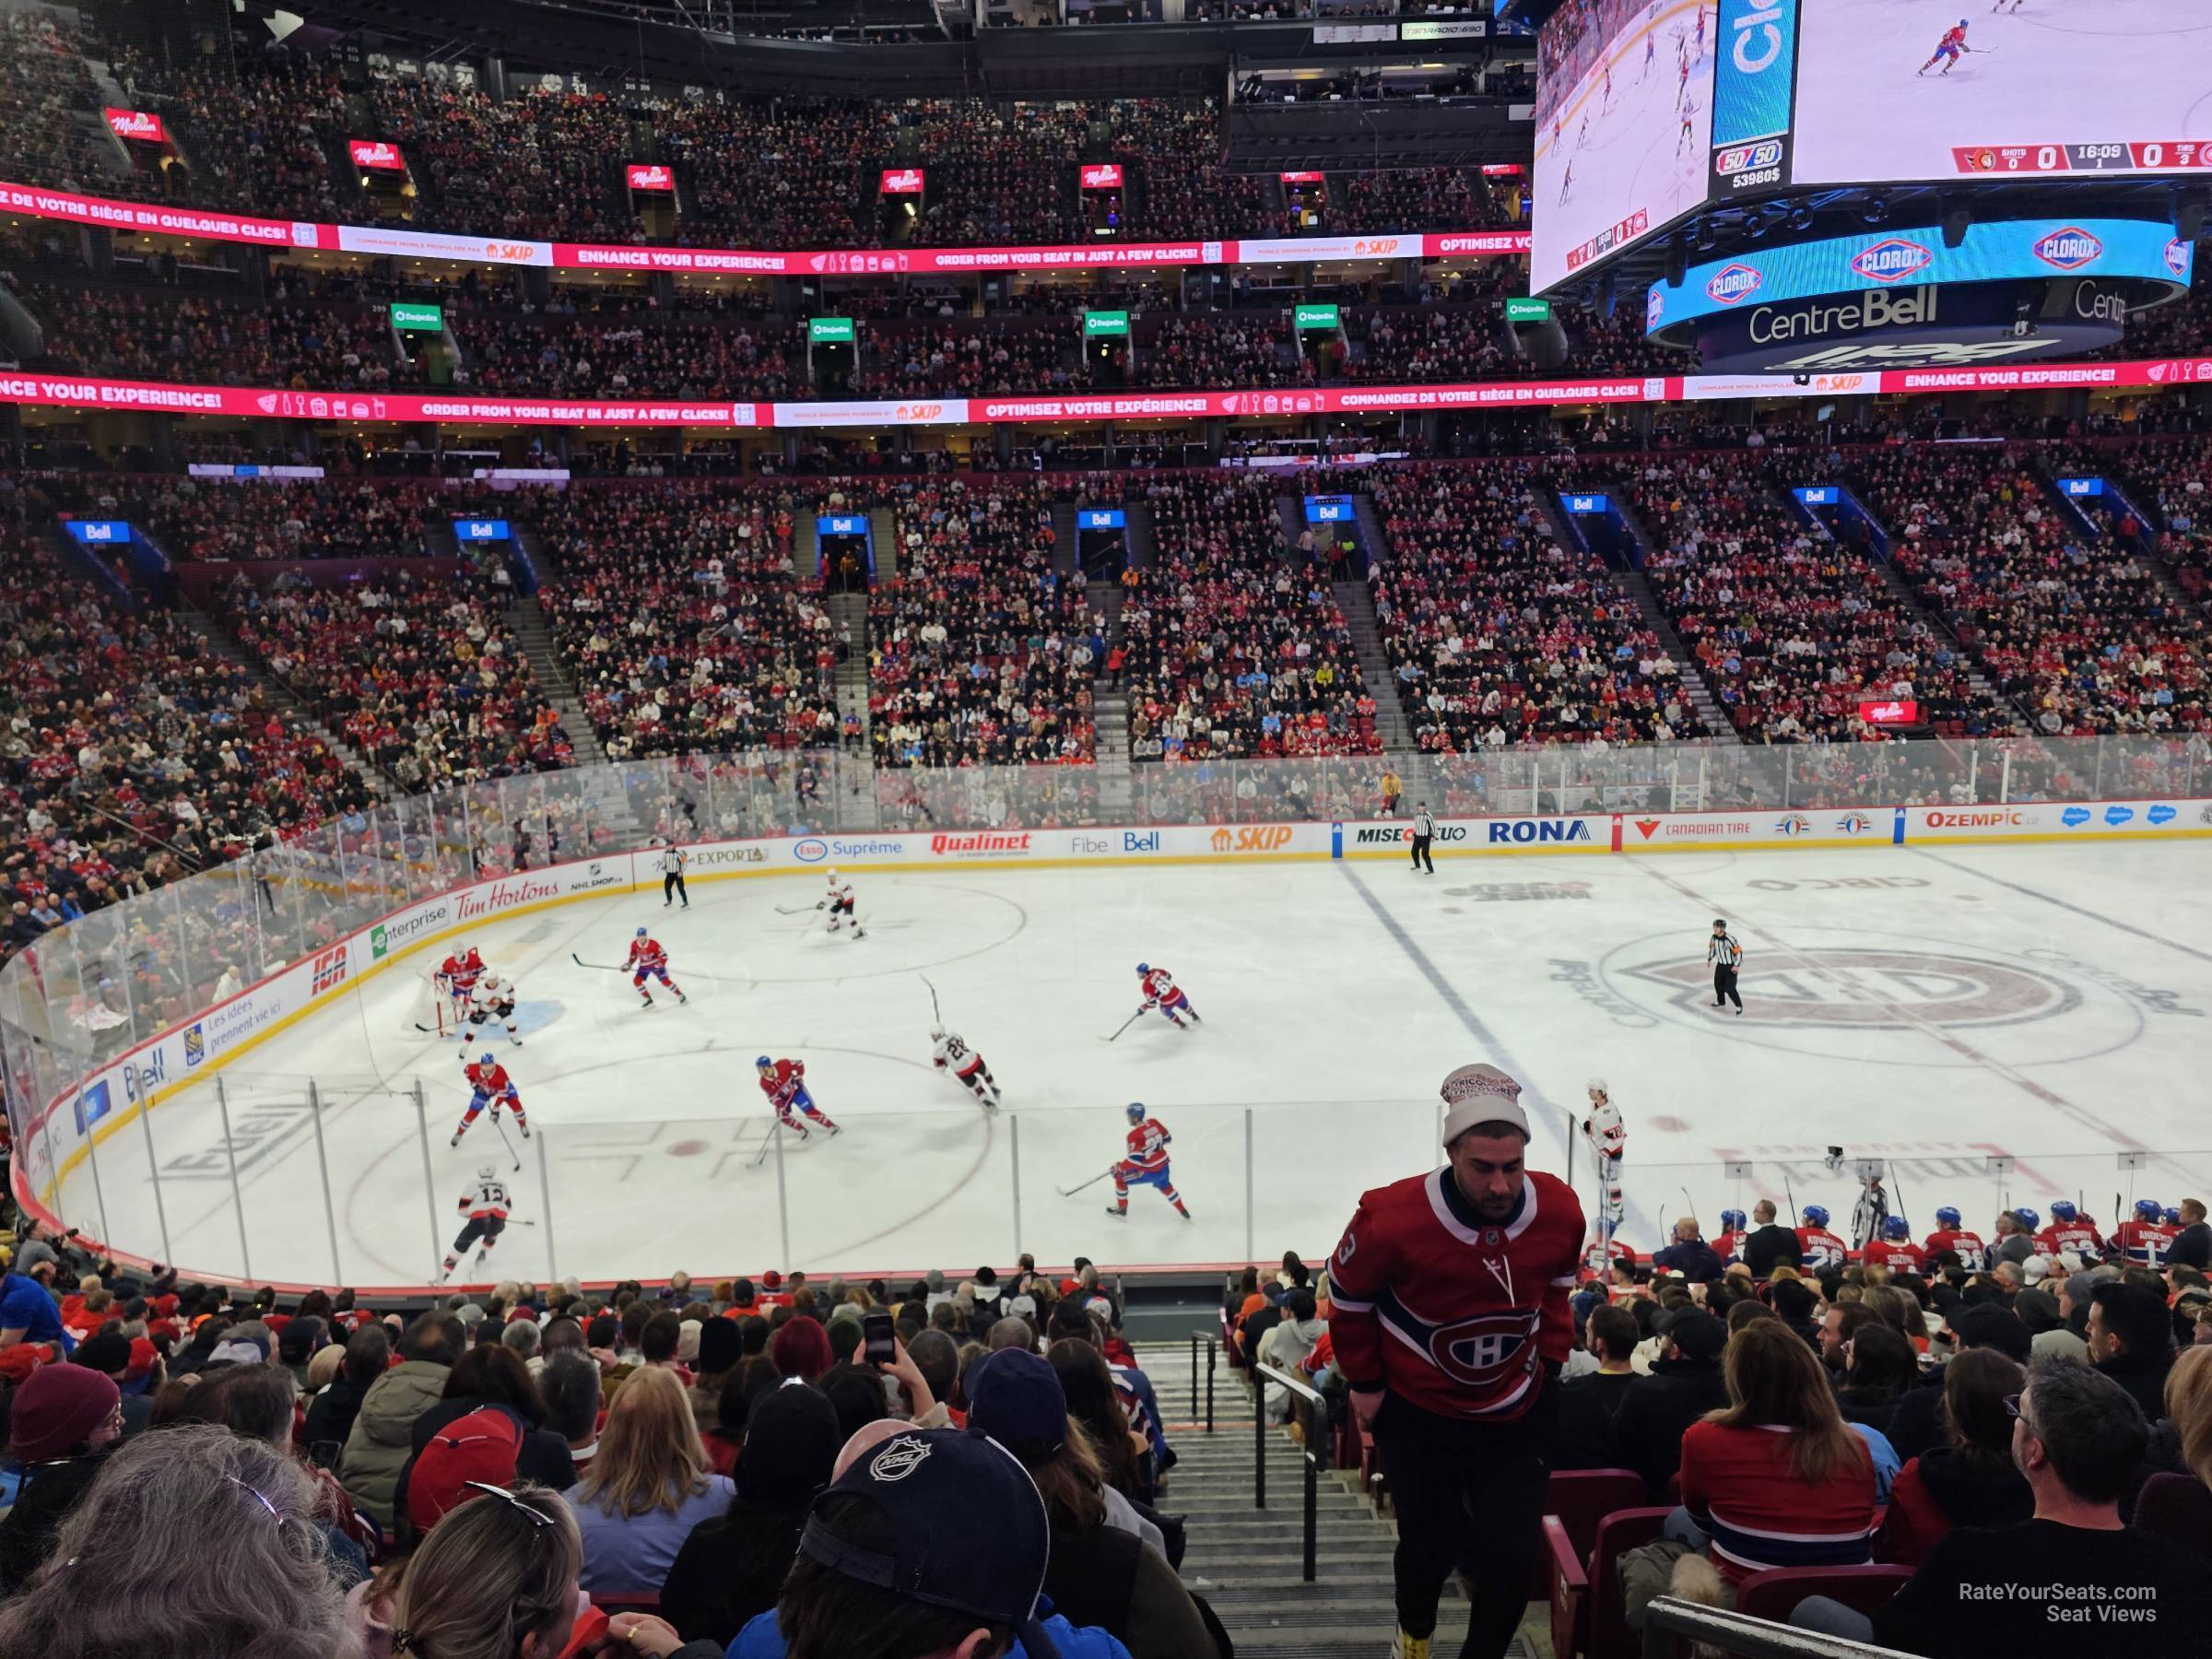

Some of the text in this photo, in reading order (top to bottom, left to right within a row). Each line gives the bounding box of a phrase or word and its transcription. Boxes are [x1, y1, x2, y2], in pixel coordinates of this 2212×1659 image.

[111, 116, 156, 132] Molson
[355, 147, 394, 161] Molson
[2037, 147, 2056, 169] 0
[2077, 145, 2122, 159] 16:09
[2143, 144, 2162, 166] 0
[630, 171, 667, 188] Molson
[887, 175, 920, 191] Molson
[1084, 170, 1118, 187] Molson
[1733, 168, 1780, 188] 53980$
[12, 193, 33, 207] DE
[37, 195, 88, 216] VOTRE
[90, 204, 134, 222] SIÈGE
[137, 211, 158, 226] EN
[160, 214, 239, 235] QUELQUES
[500, 244, 535, 261] SKIP
[1368, 239, 1397, 254] SKIP
[1440, 236, 1512, 252] OPTIMISEZ
[2042, 239, 2096, 259] CLOROX
[578, 249, 785, 270] ENHANCE YOUR EXPERIENCE!
[935, 249, 1197, 266] ORDER FROM YOUR SEAT IN JUST A FEW CLICKS!
[1862, 245, 1928, 272] CLOROX
[1712, 273, 1756, 295] CLOROX
[1829, 375, 1863, 391] SKIP
[1905, 369, 2115, 387] ENHANCE YOUR EXPERIENCE!
[41, 382, 96, 400] YOUR
[100, 386, 221, 408] EXPERIENCE!
[1341, 385, 1638, 406] COMMANDEZ DE VOTRE SIÈGE EN QUELQUES CLICS!
[421, 403, 729, 421] ORDER FROM YOUR SEAT IN JUST A FEW CLICKS!
[910, 405, 942, 420] SKIP
[986, 398, 1207, 417] OPTIMISEZ VOTRE EXPÉRIENCE!
[1806, 490, 1824, 502] Bell
[2070, 482, 2088, 494] Bell
[1320, 506, 1338, 519] Bell
[1574, 499, 1593, 510] Bell
[833, 519, 852, 532] Bell
[1092, 512, 1111, 525] Bell
[86, 524, 111, 539] Bell
[472, 523, 492, 536] Bell
[1489, 820, 1591, 842] RONA
[1666, 822, 1750, 836] CANADIAN TIRE
[932, 832, 1030, 855] Qualinet
[1071, 831, 1159, 853] Fibe Bell
[1234, 826, 1293, 851] SKIP
[800, 841, 902, 857] Esso Suprême
[454, 881, 559, 920] Tim Hortons
[374, 907, 447, 948] enterprise
[208, 999, 253, 1030] Les idées
[211, 1002, 281, 1053] prennent vie ici
[124, 1047, 164, 1103] Bell
[482, 1187, 503, 1203] 12
[879, 1453, 914, 1468] NHL
